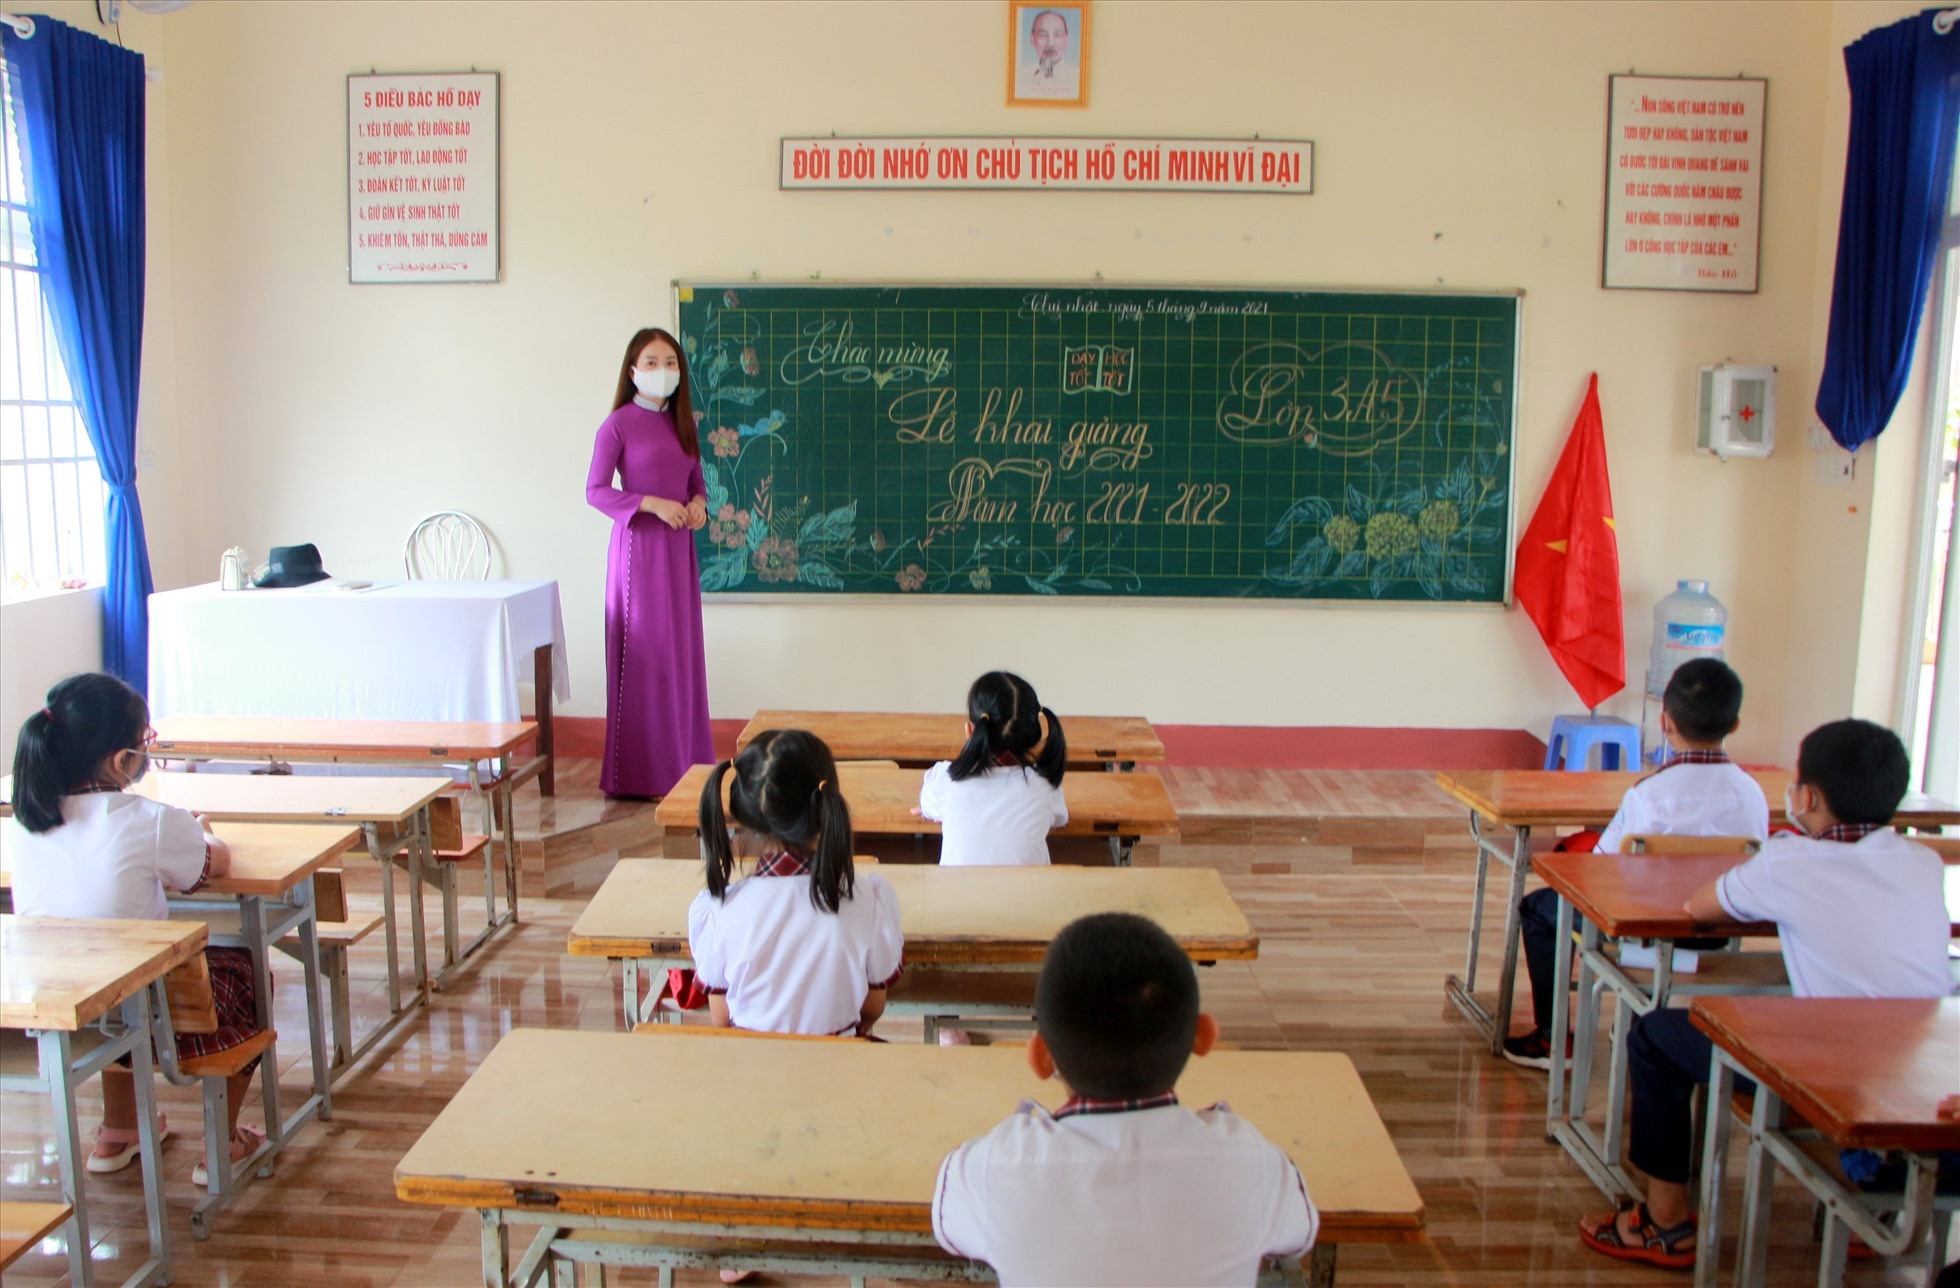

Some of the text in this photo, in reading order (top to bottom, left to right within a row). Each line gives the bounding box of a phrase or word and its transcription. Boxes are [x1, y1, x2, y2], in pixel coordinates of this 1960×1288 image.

[365, 92, 371, 108] 5
[376, 88, 403, 107] ĐIỀU
[437, 87, 454, 107] HỒ
[458, 91, 481, 110] DẠY
[359, 124, 365, 137] 1.
[367, 121, 380, 137] YÊU
[394, 120, 415, 138] QUỐC,
[418, 120, 430, 136] YÊU
[433, 119, 453, 136] ĐỒNG
[455, 119, 470, 136] BÀO
[359, 147, 467, 168] 2. HỌC TẬP TỐT, LAO ĐỘNG TỐT
[793, 139, 1299, 187] ĐỜI ĐỜI NHỚ ƠN CHỦ TỊCH HỒ CHÍ MINH VĨ ĐẠI
[359, 179, 365, 193] 3.
[368, 176, 387, 192] ĐOÀN
[390, 176, 402, 192] KẾT
[405, 175, 420, 193] TỐT,
[434, 175, 450, 194] LUẬT
[453, 174, 465, 192] TỐT
[359, 202, 460, 222] 4. GIỮ GÌN VỆ SINH THẬT TỐT
[1146, 299, 1154, 313] 5
[1158, 298, 1196, 323] tháng
[1197, 301, 1208, 313] 9
[1242, 301, 1268, 315] 2021
[878, 341, 952, 383] mừng
[1324, 376, 1409, 422] 3A5
[888, 387, 957, 443] Lễ
[969, 387, 1053, 444] khai
[1087, 481, 1150, 524] 2021
[1165, 483, 1231, 525] 2022
